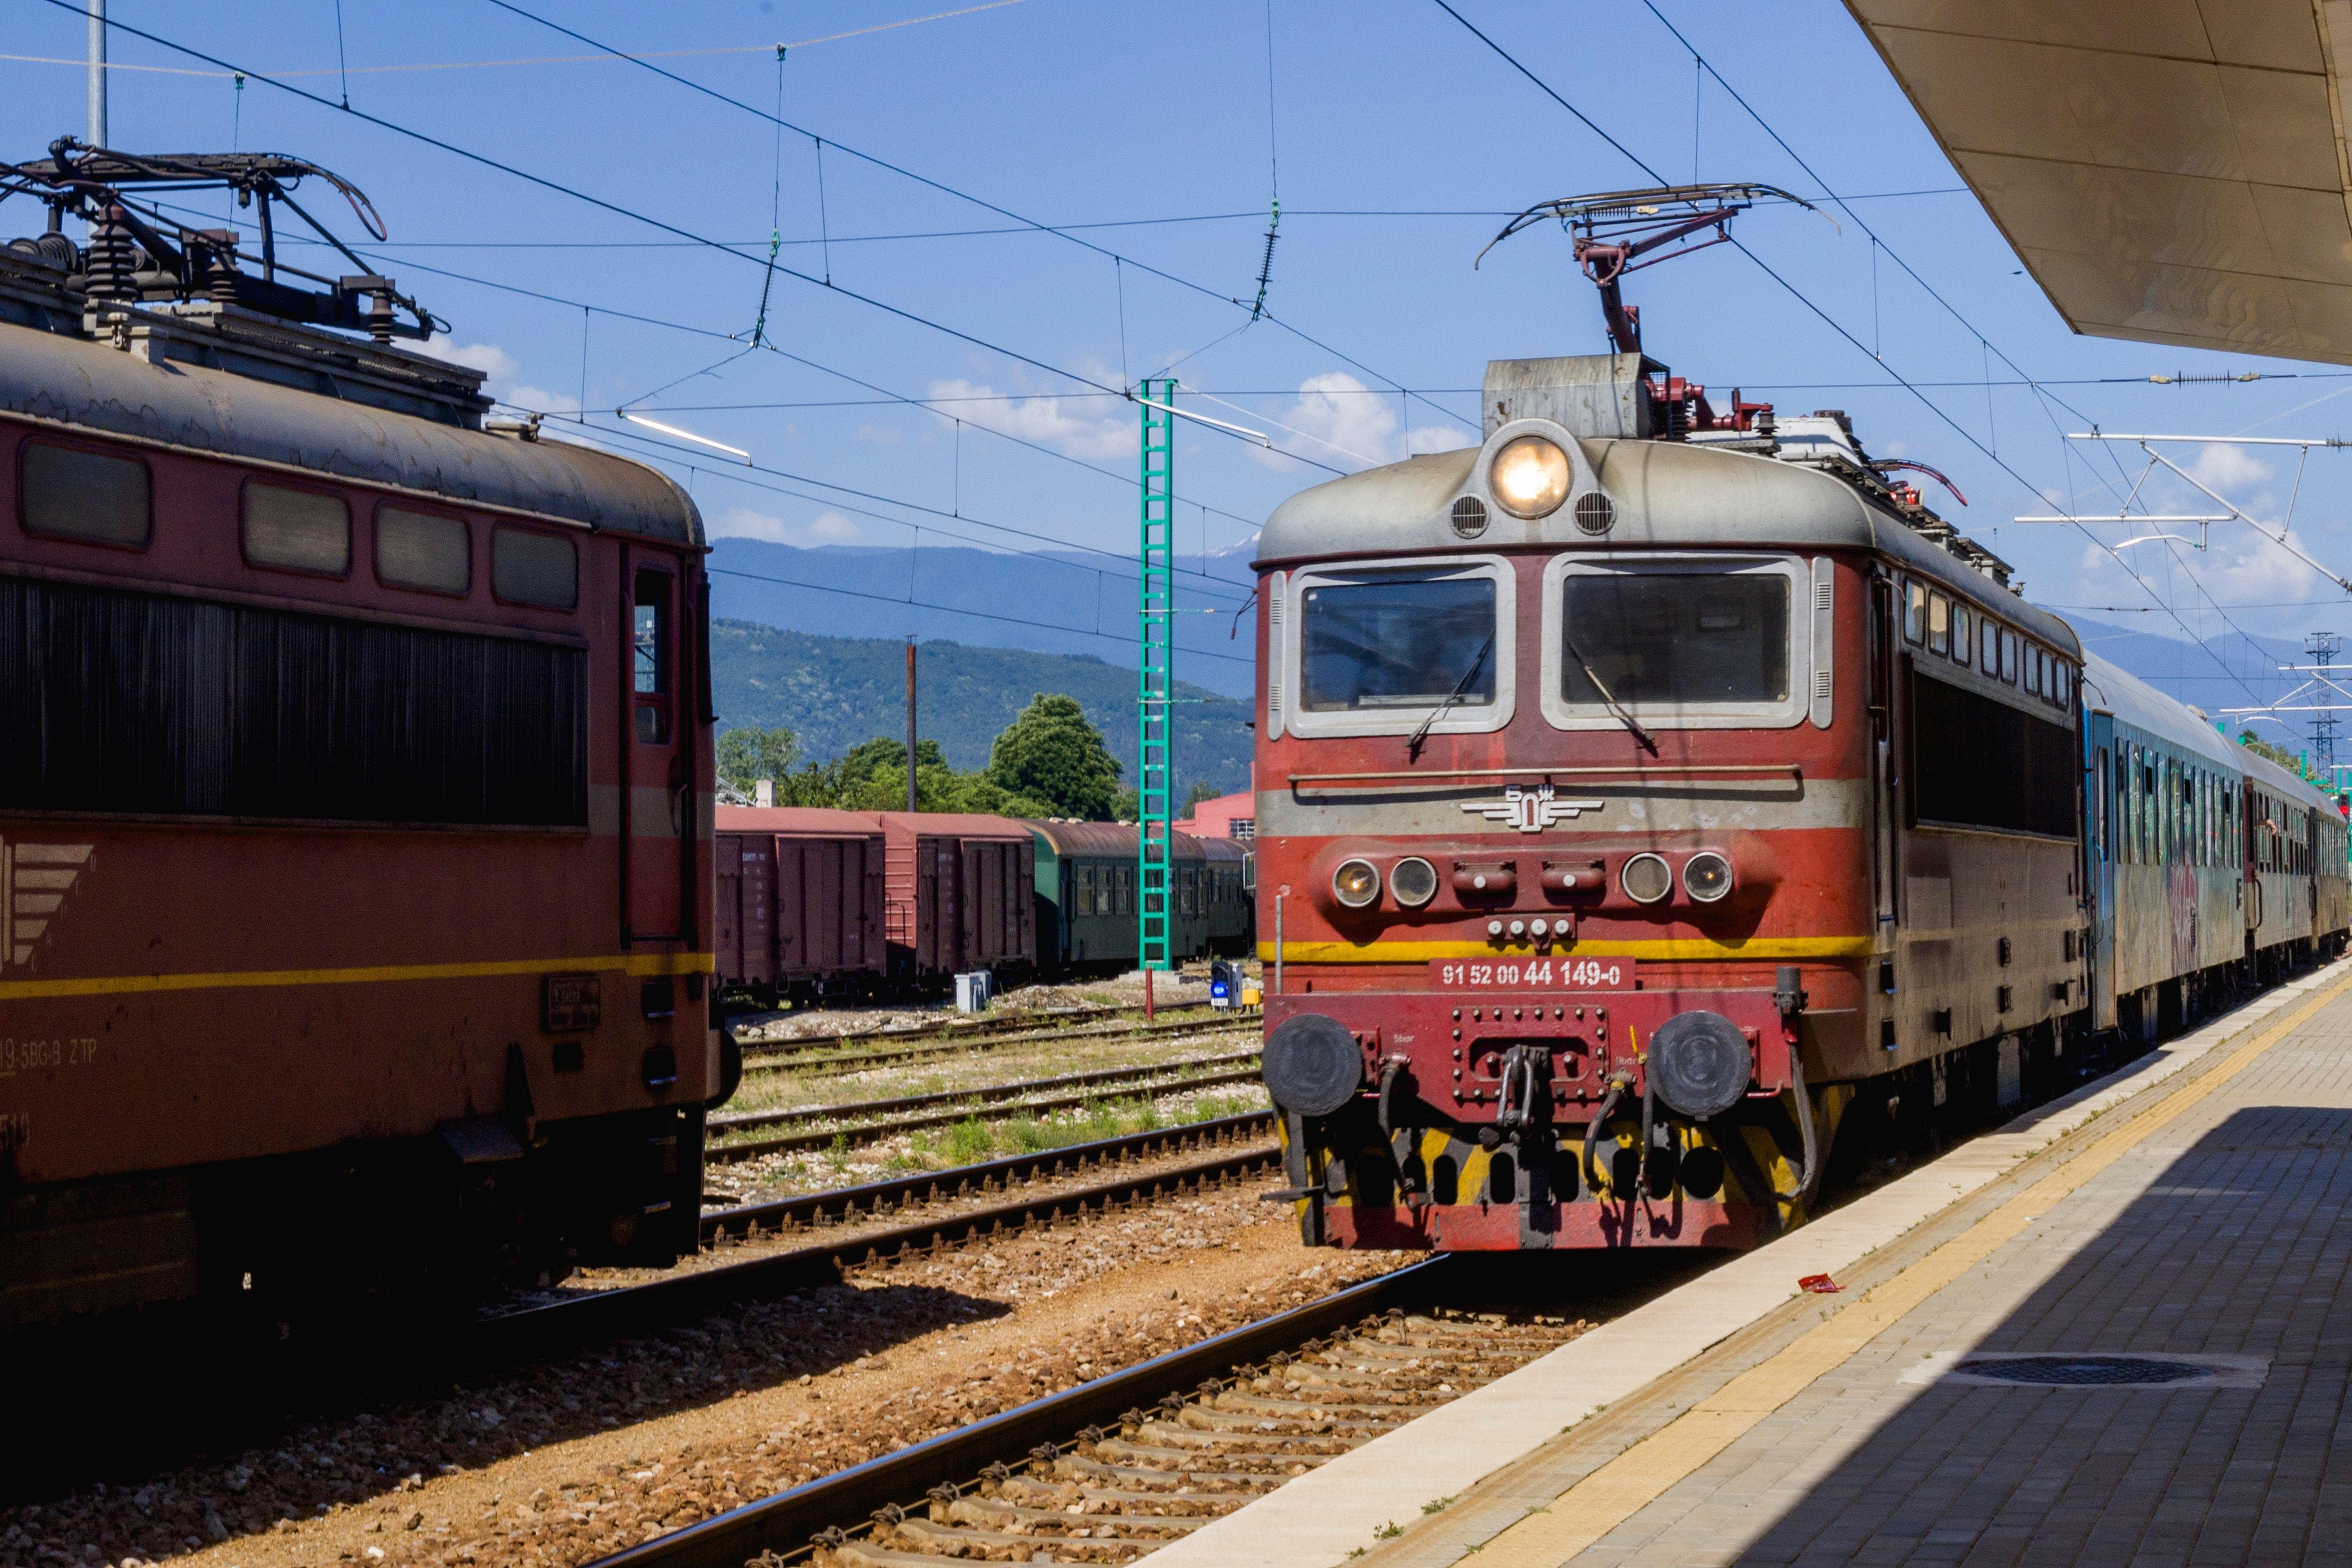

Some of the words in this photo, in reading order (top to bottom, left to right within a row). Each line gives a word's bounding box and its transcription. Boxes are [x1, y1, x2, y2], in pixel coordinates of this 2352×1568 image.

[1443, 965, 1464, 985] 91
[1470, 965, 1492, 985] 52
[1496, 965, 1520, 985] 00
[1524, 961, 1553, 986] 44
[1560, 961, 1620, 986] 149-0
